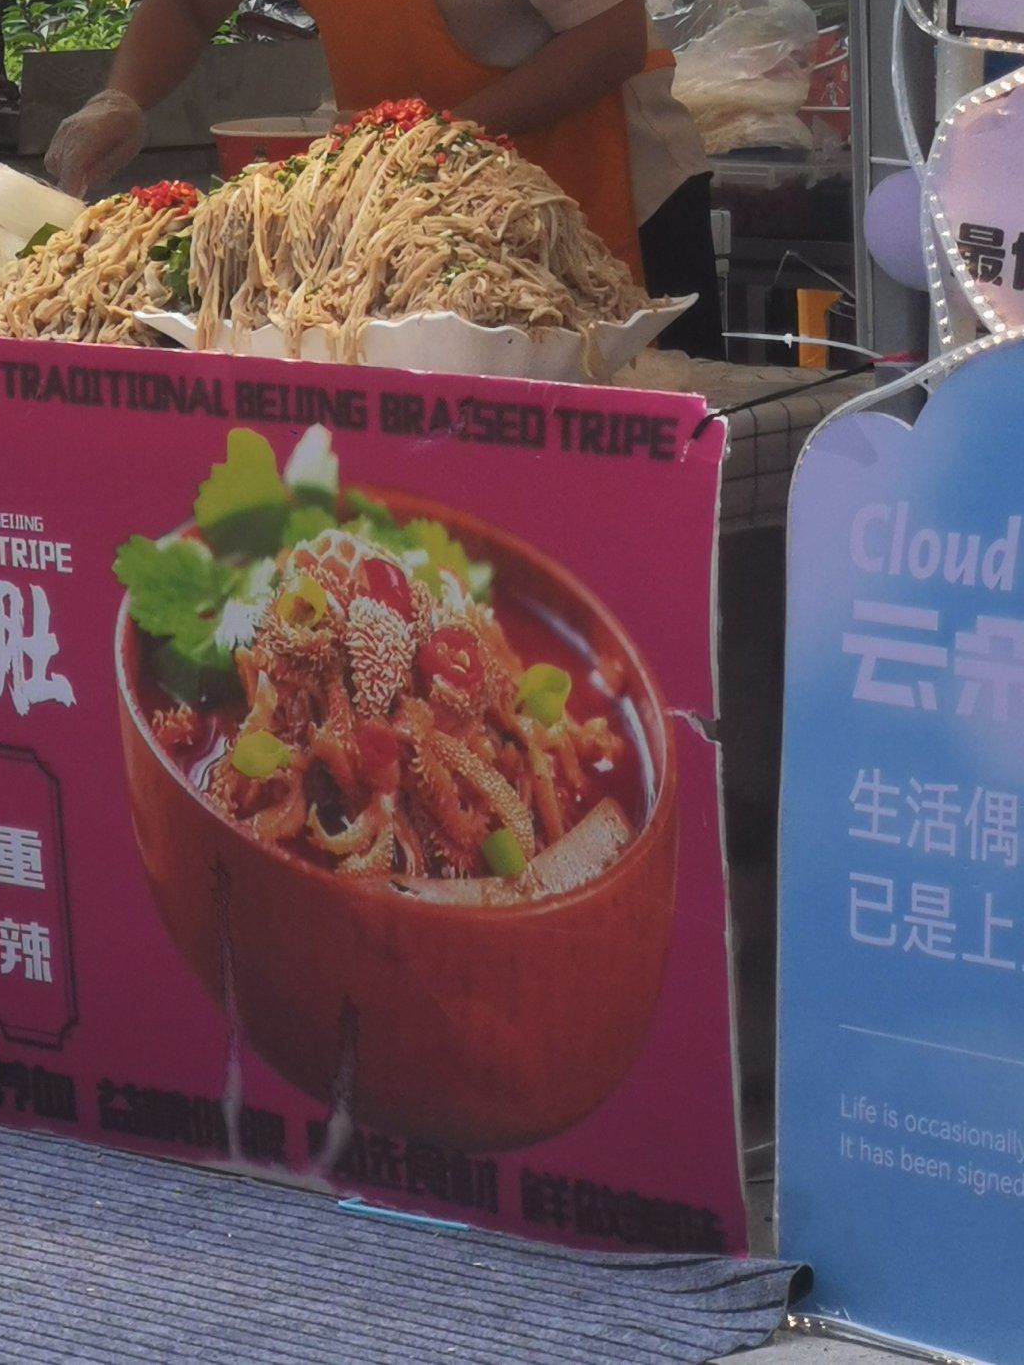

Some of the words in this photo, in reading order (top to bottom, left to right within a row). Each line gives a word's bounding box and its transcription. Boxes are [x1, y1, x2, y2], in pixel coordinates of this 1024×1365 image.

[0, 360, 228, 419] TRADITIONAL
[234, 380, 368, 431] BEIJING
[379, 393, 547, 449] BRAISED
[553, 407, 683, 462] TRIPE
[850, 500, 1023, 591] Cloud
[848, 768, 1020, 868] 生活偶
[840, 1093, 877, 1124] Life
[883, 1102, 898, 1129] is
[905, 1113, 1024, 1164] occasionally
[840, 1136, 854, 1159] It
[860, 1137, 894, 1169] has
[900, 1151, 951, 1181] been
[957, 1160, 1024, 1197] signed
